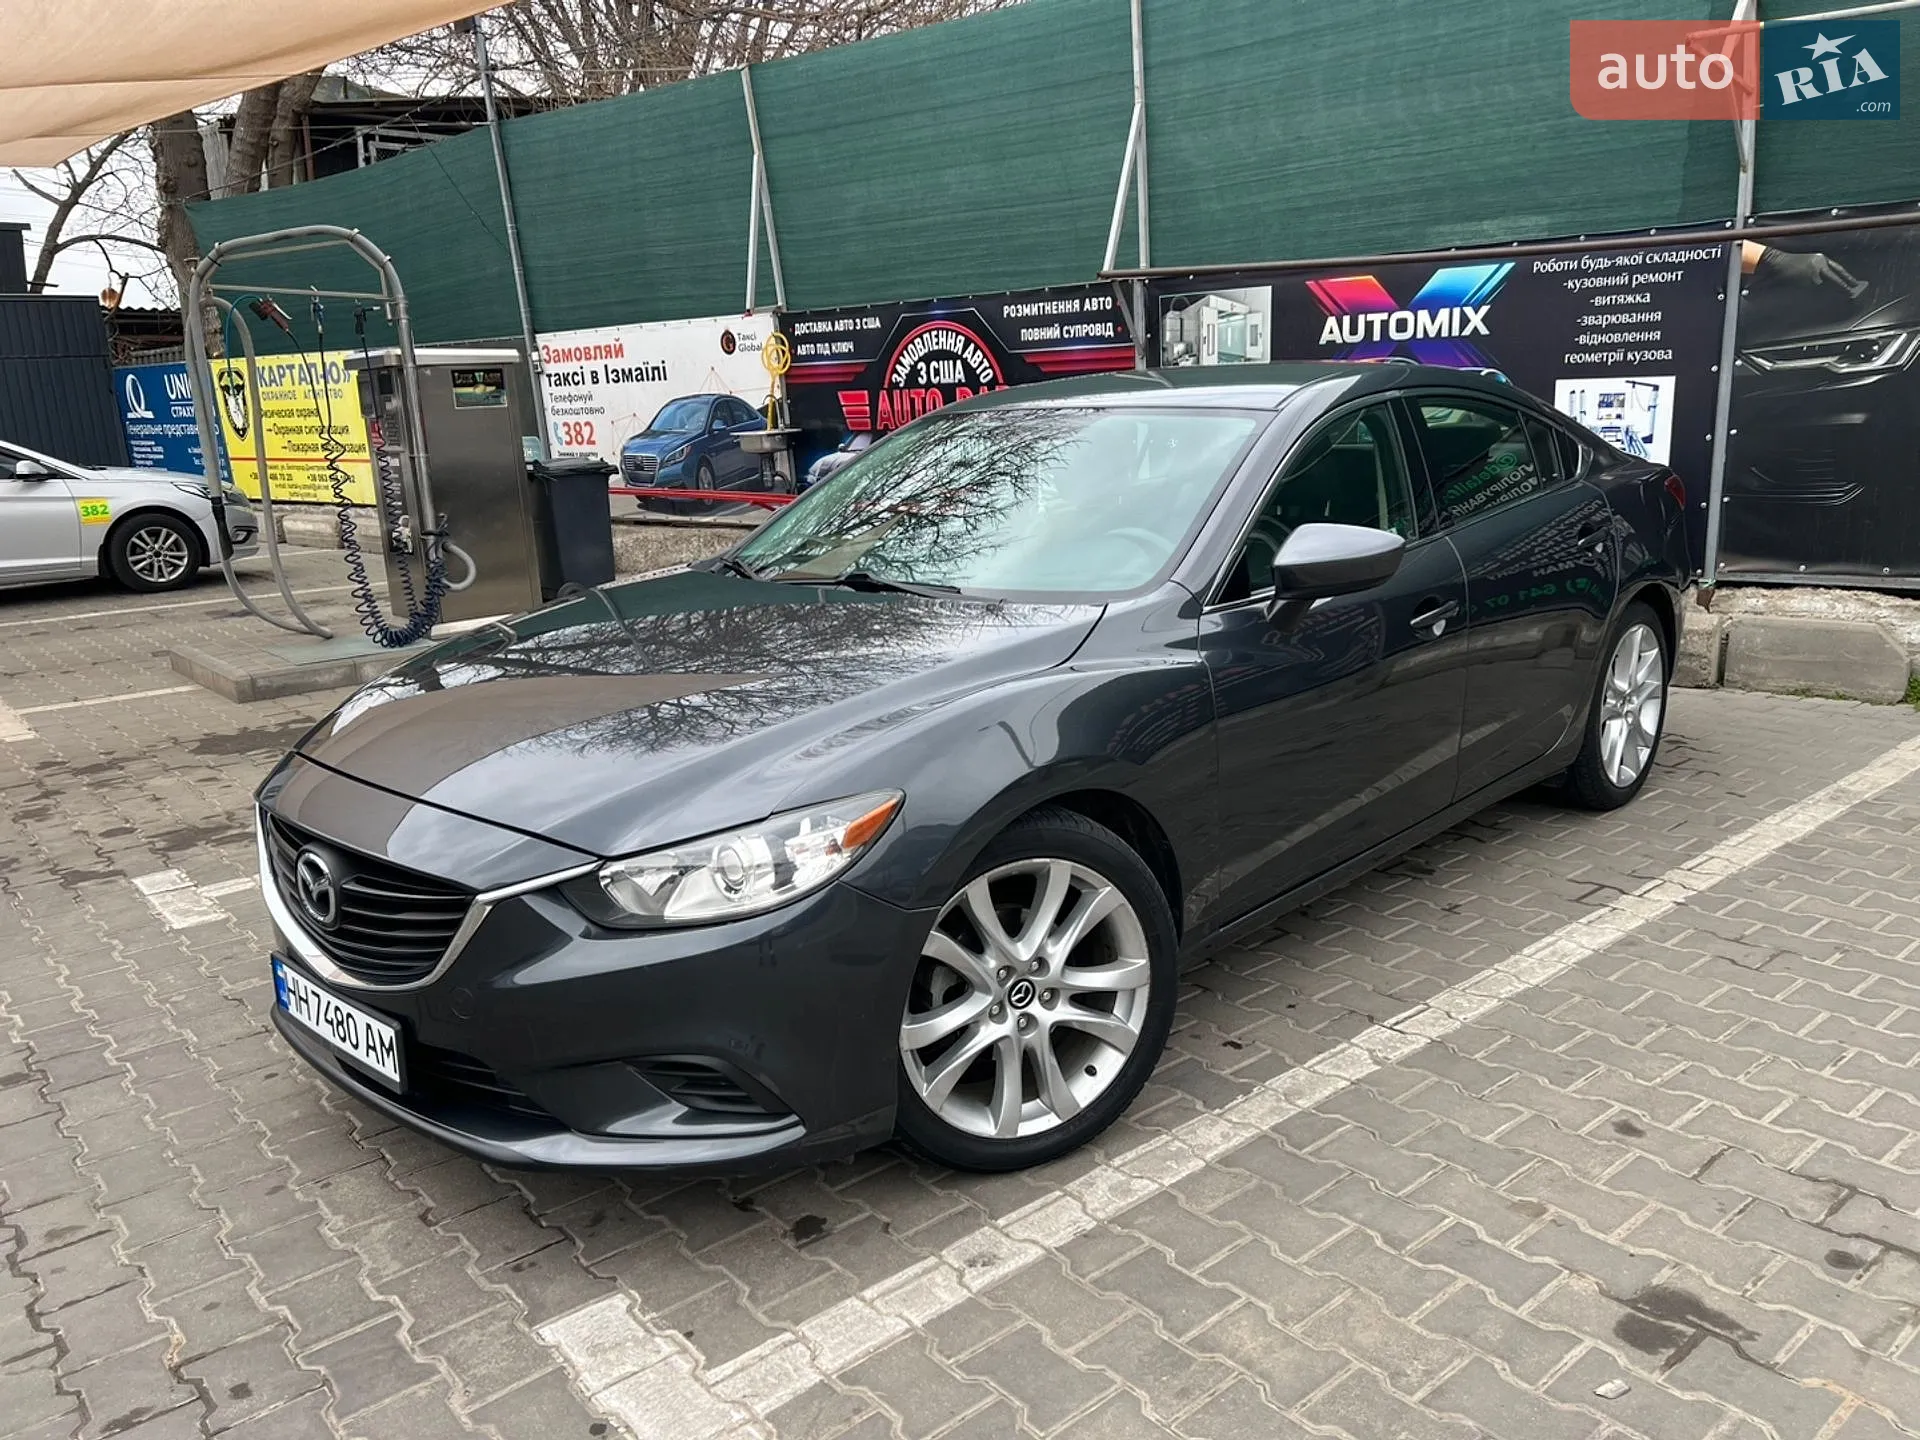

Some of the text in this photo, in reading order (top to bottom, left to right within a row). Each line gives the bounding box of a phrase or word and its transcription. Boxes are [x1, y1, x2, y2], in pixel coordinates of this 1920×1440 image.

[1533, 244, 1722, 274] Роботи будь-якої складності
[1563, 269, 1684, 293] -кузовний ремонт
[1003, 296, 1112, 319] РОЗМИТНЕННЯ АВТО
[1590, 291, 1651, 307] -витяжка
[794, 316, 882, 336] ДОСТАВКА АВТО З США
[1319, 304, 1491, 345] AUTOMIX
[1576, 310, 1662, 328] -зварювання
[737, 331, 757, 342] Таксі
[1021, 322, 1115, 342] ПОВНИЙ СУПРОВІД
[1574, 329, 1661, 346] -відновлення
[541, 337, 625, 364] Замовляй
[738, 342, 763, 352] Global
[797, 344, 817, 356] АВТО
[831, 341, 855, 354] КЛЮЧ
[891, 329, 994, 388] ЗАМОВЛЕННЯ АВТО
[1564, 349, 1673, 366] геометрії кузова
[546, 360, 668, 388] таксі в Ізмаїлі
[917, 359, 966, 385] З США
[550, 391, 594, 405] Телефонуй
[875, 387, 944, 429] AUTO
[551, 406, 605, 416] безкоштовно
[562, 420, 597, 446] 382
[81, 504, 110, 517] 382
